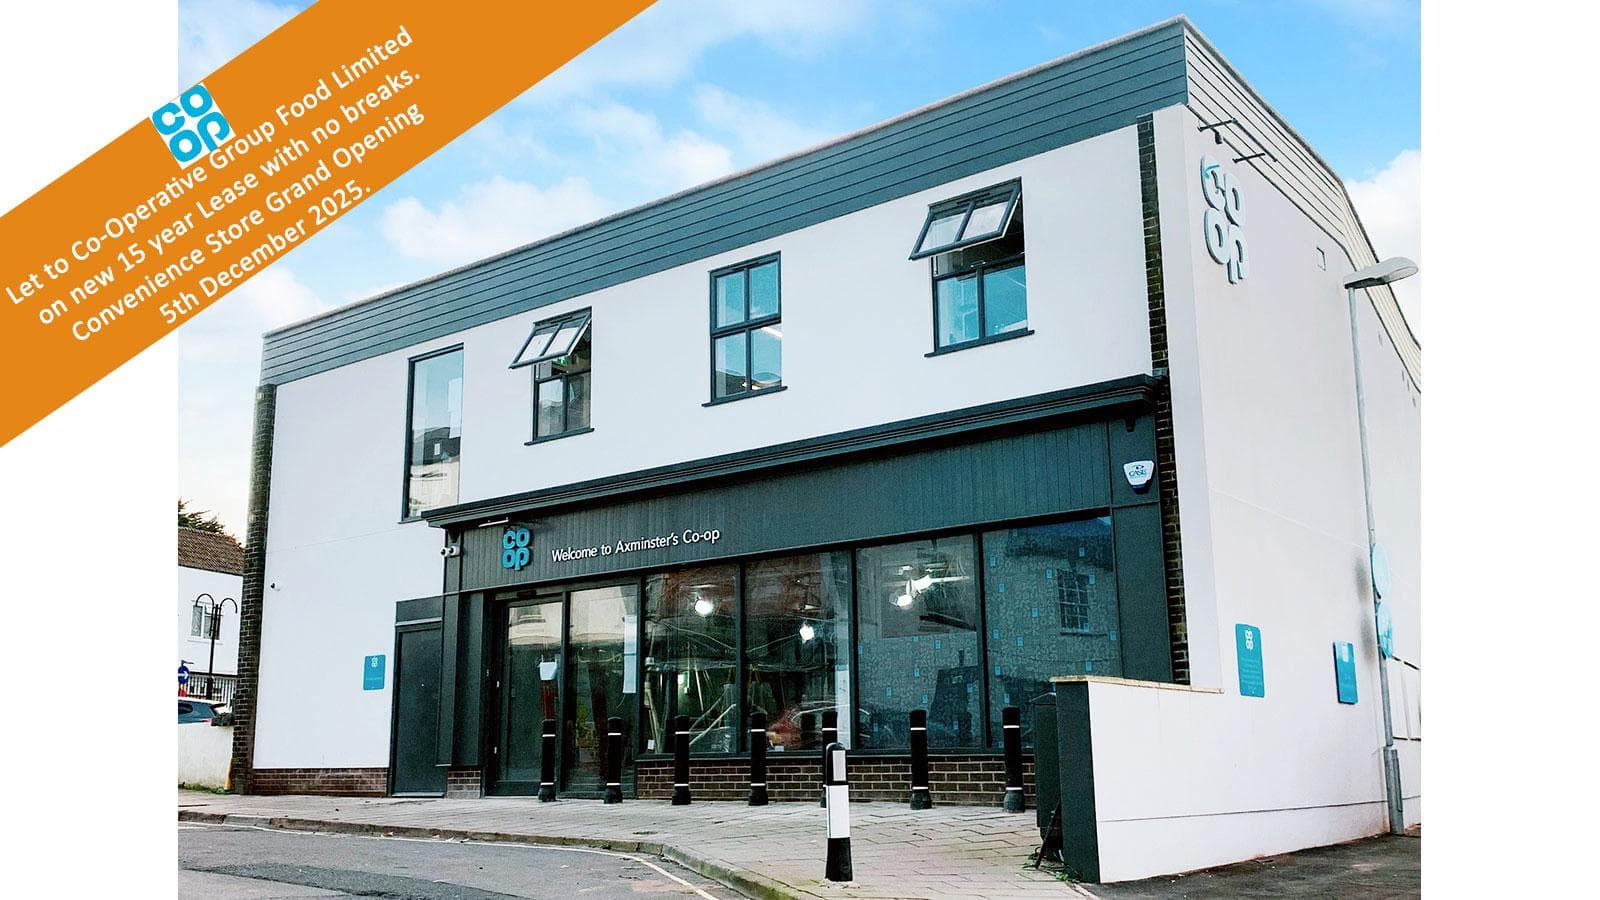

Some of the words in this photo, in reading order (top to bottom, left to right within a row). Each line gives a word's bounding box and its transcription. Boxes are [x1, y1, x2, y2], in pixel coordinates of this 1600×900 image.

[551, 546, 598, 562] Welcome
[600, 543, 612, 556] to
[615, 532, 679, 554] Axminster's
[682, 529, 721, 544] Co-op
